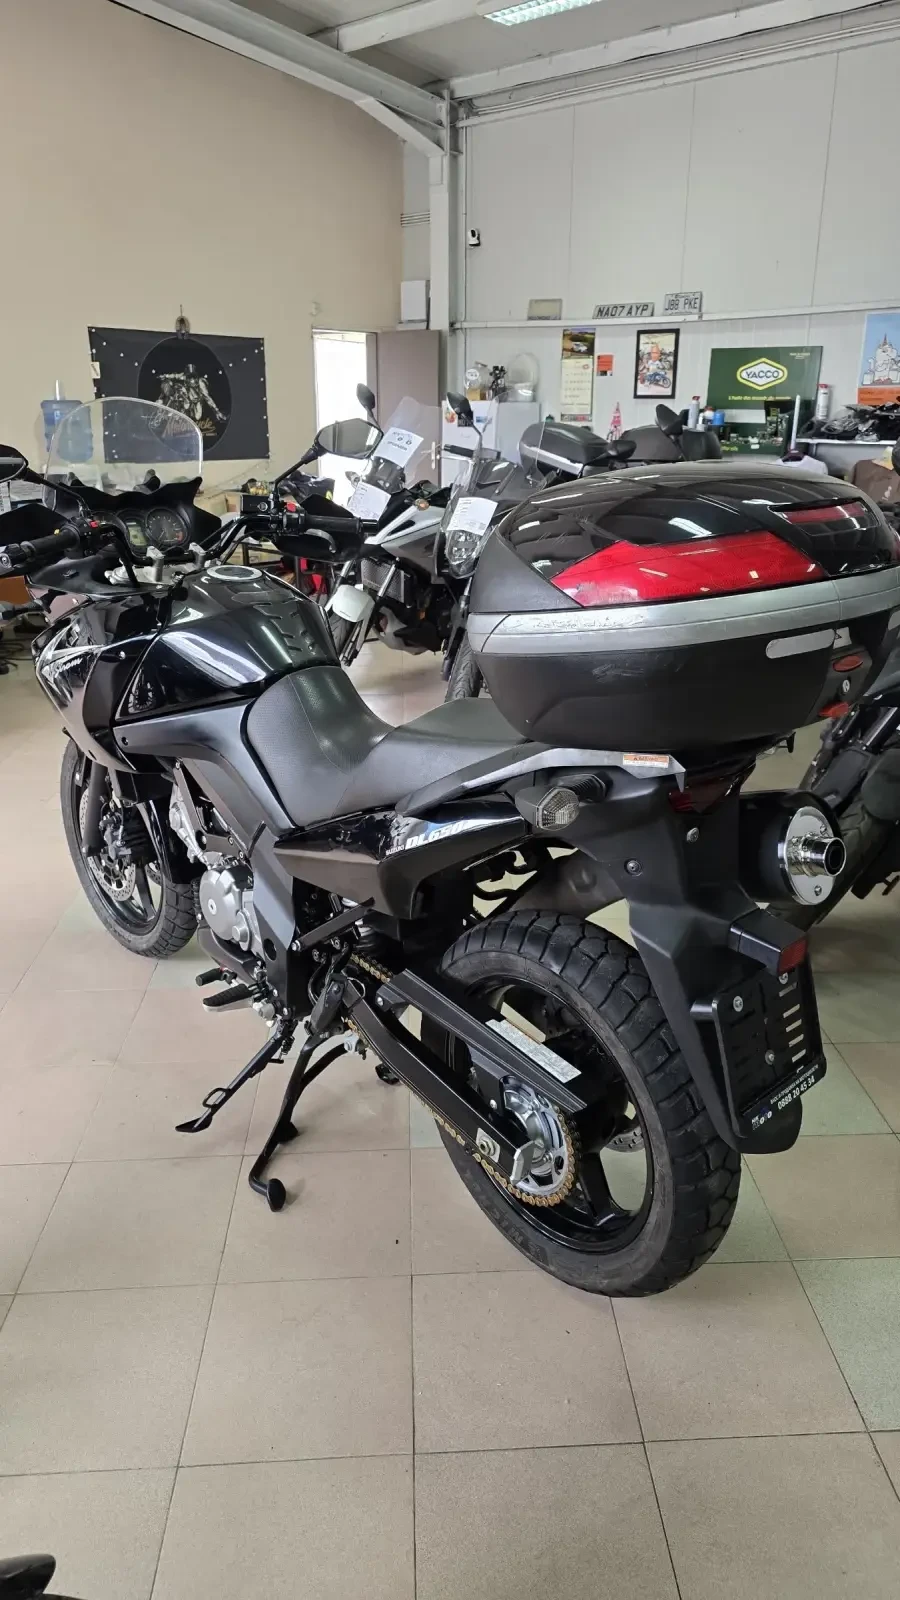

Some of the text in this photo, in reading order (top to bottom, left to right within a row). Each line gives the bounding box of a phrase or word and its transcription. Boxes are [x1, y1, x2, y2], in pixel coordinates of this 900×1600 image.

[683, 298, 699, 310] PKE
[597, 304, 649, 317] NA07 AYP
[745, 370, 780, 379] YACCO
[385, 844, 405, 856] SUZUKI
[800, 1081, 808, 1092] 45
